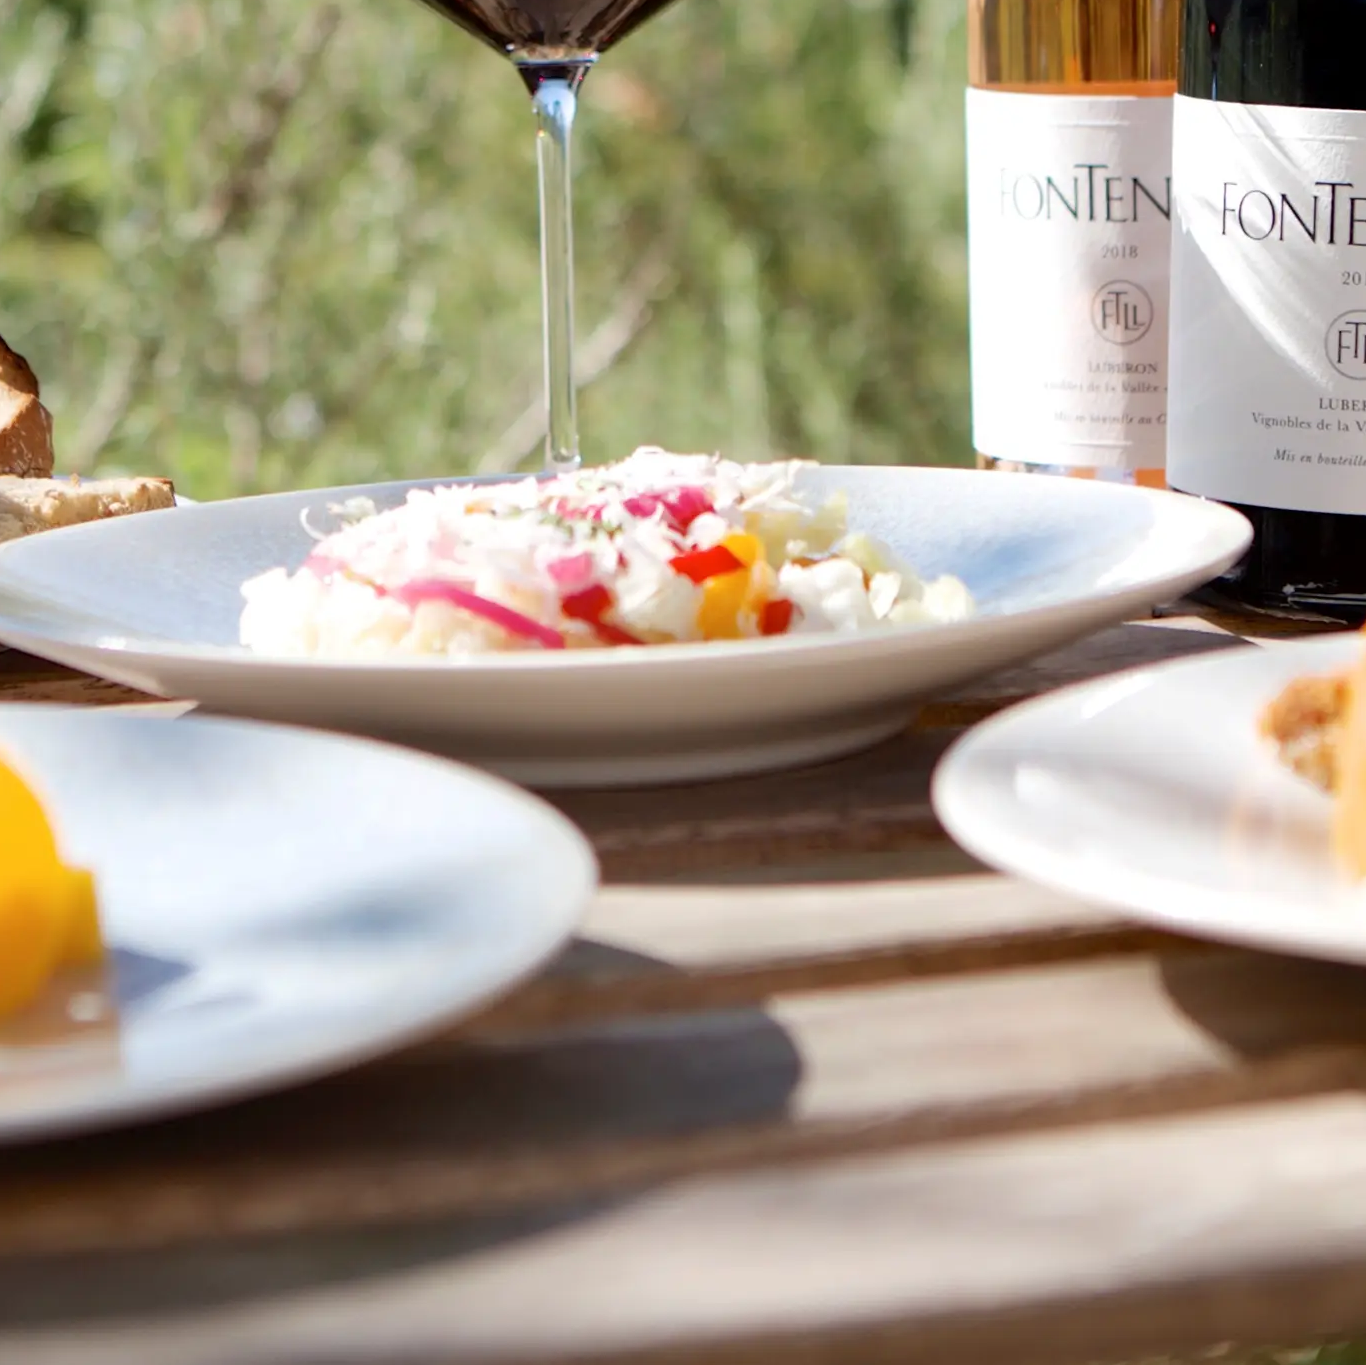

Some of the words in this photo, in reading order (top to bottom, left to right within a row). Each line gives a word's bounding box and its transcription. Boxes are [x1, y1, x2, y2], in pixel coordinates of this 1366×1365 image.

[1000, 163, 1172, 223] FONTEN
[1101, 245, 1139, 259] 2018
[1251, 412, 1313, 430] Vignobles
[1316, 418, 1332, 431] de
[1337, 419, 1350, 432] la
[1273, 447, 1296, 463] Mis
[1299, 454, 1312, 464] en
